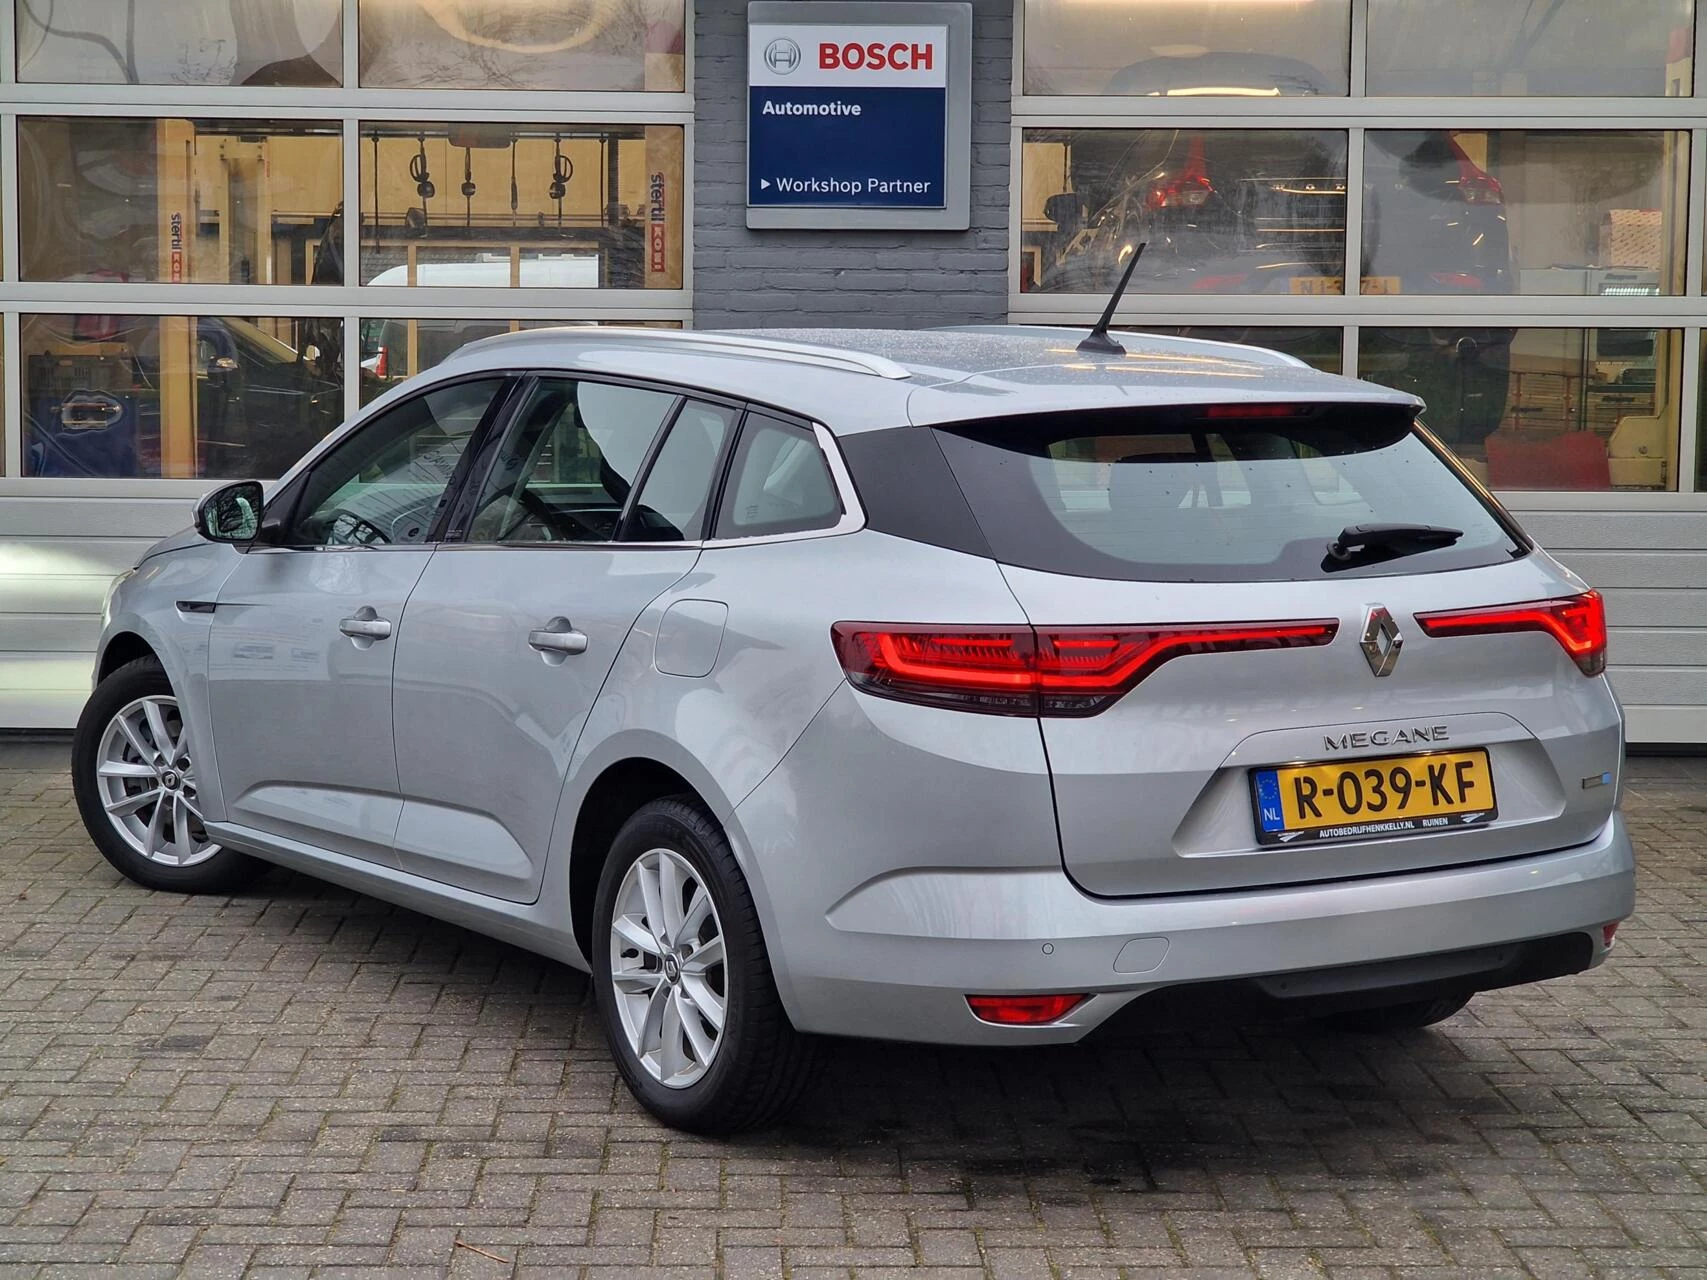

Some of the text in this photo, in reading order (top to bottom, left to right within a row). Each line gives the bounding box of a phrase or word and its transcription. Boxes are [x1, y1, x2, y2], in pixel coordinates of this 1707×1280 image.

[818, 42, 933, 71] BOSCH
[762, 100, 862, 116] Automotive
[651, 172, 665, 222] stertil
[776, 177, 931, 195] Workshop Partner
[171, 213, 182, 250] stertil
[1323, 725, 1450, 751] MEGANE
[1293, 760, 1474, 819] R-039-KF
[1263, 807, 1281, 821] NL
[1319, 820, 1415, 838] AUTOBEDRIJFHENKKELLY.NL
[1422, 817, 1449, 828] RUINEN
